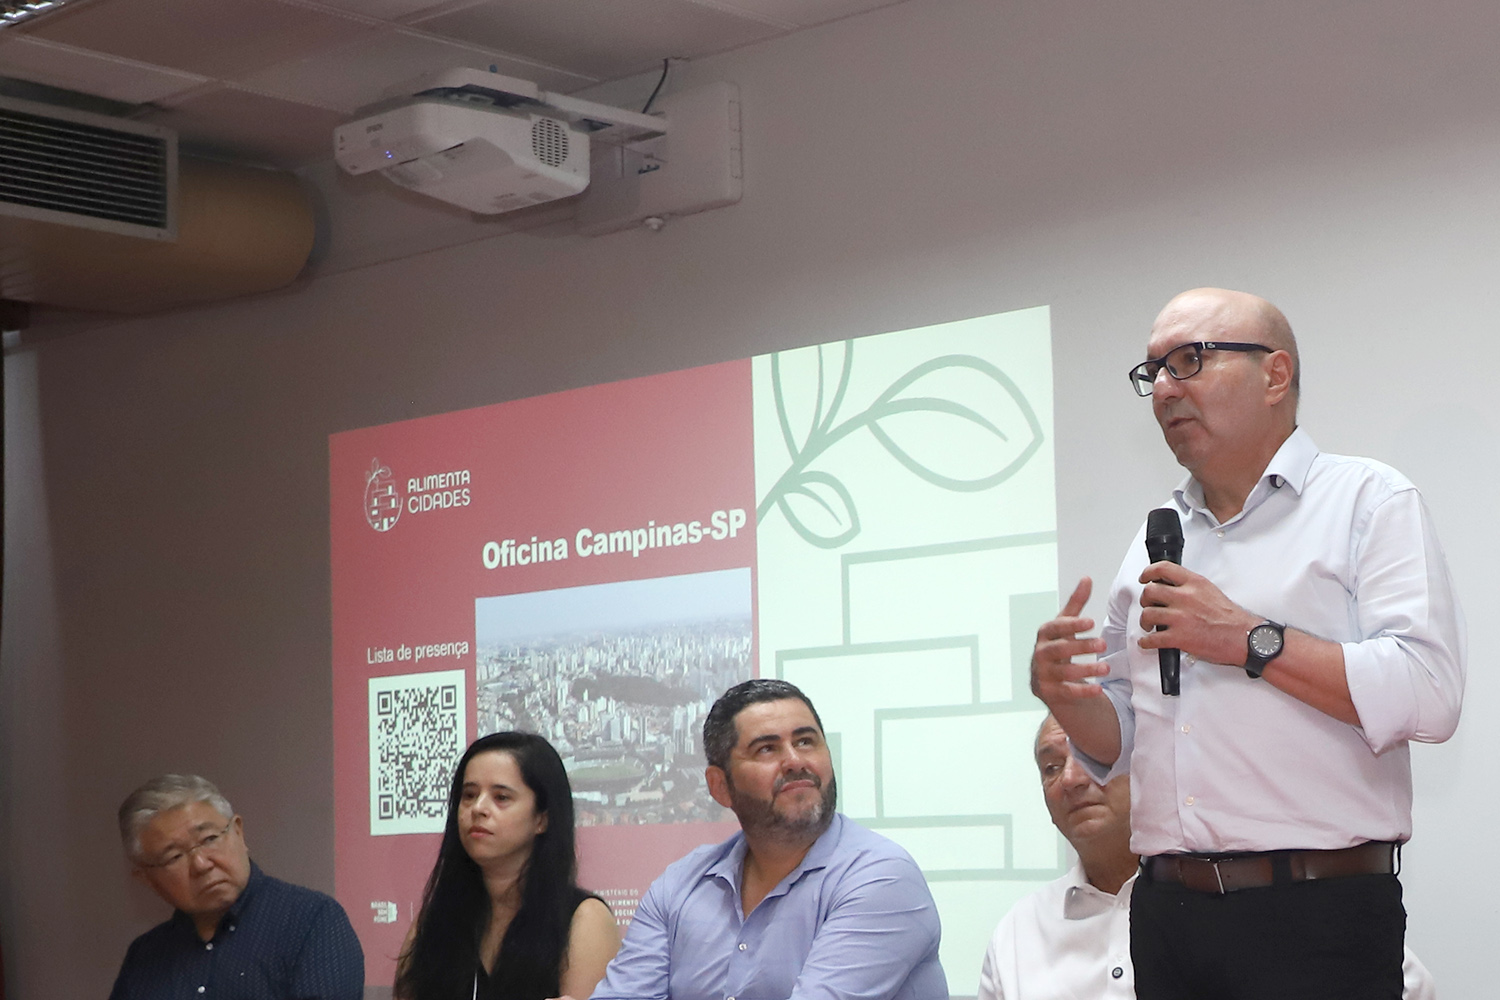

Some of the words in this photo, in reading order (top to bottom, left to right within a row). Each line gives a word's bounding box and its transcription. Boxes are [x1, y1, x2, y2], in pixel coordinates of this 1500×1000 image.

[407, 469, 470, 494] ALIMENTA
[407, 488, 471, 514] CIDADES
[482, 536, 569, 570] Oficina
[575, 508, 747, 558] Campinas-SP
[367, 646, 394, 664] Lista
[397, 643, 412, 661] de
[415, 641, 469, 663] presença
